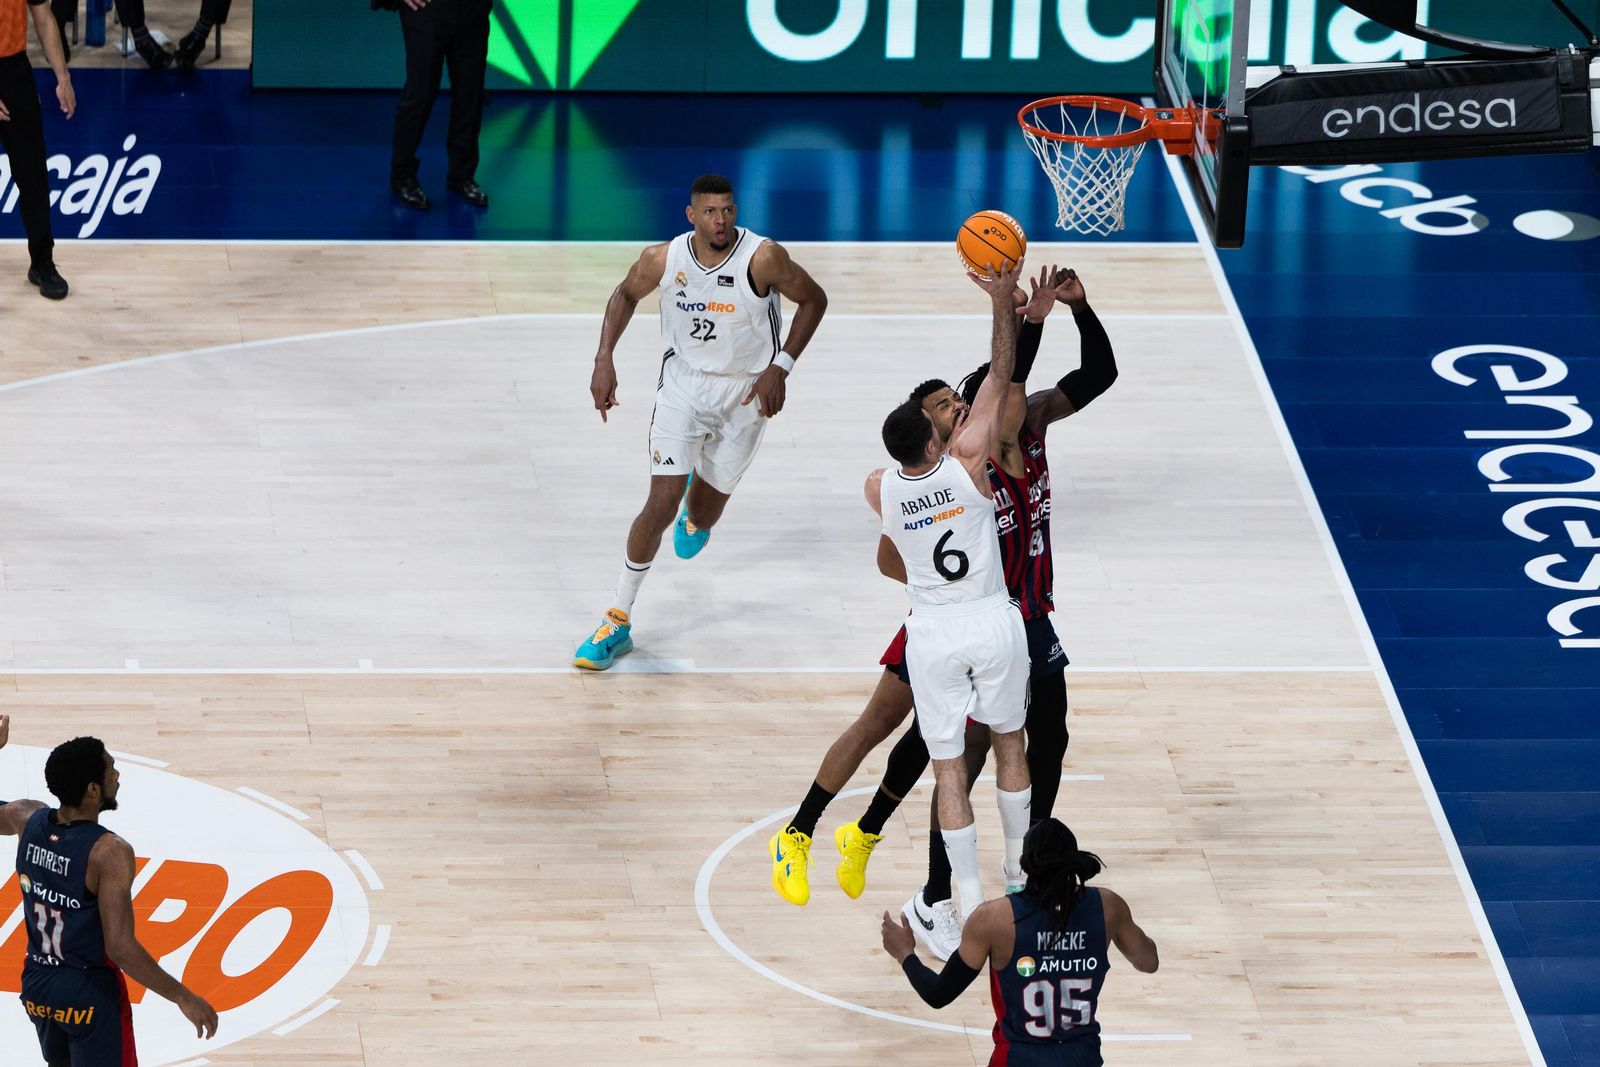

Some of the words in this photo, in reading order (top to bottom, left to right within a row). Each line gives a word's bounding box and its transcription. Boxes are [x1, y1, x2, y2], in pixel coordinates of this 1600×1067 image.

[1322, 93, 1517, 139] endesa
[990, 226, 1007, 241] acb
[676, 301, 736, 313] AUTOHERO
[689, 318, 717, 342] 22
[900, 487, 956, 516] ABALDE
[904, 506, 965, 531] AUTOHERO
[933, 528, 970, 582] 6
[26, 843, 71, 877] FORREST
[34, 902, 65, 960] 11
[1039, 957, 1098, 973] AMUTIO
[1023, 978, 1093, 1037] 95
